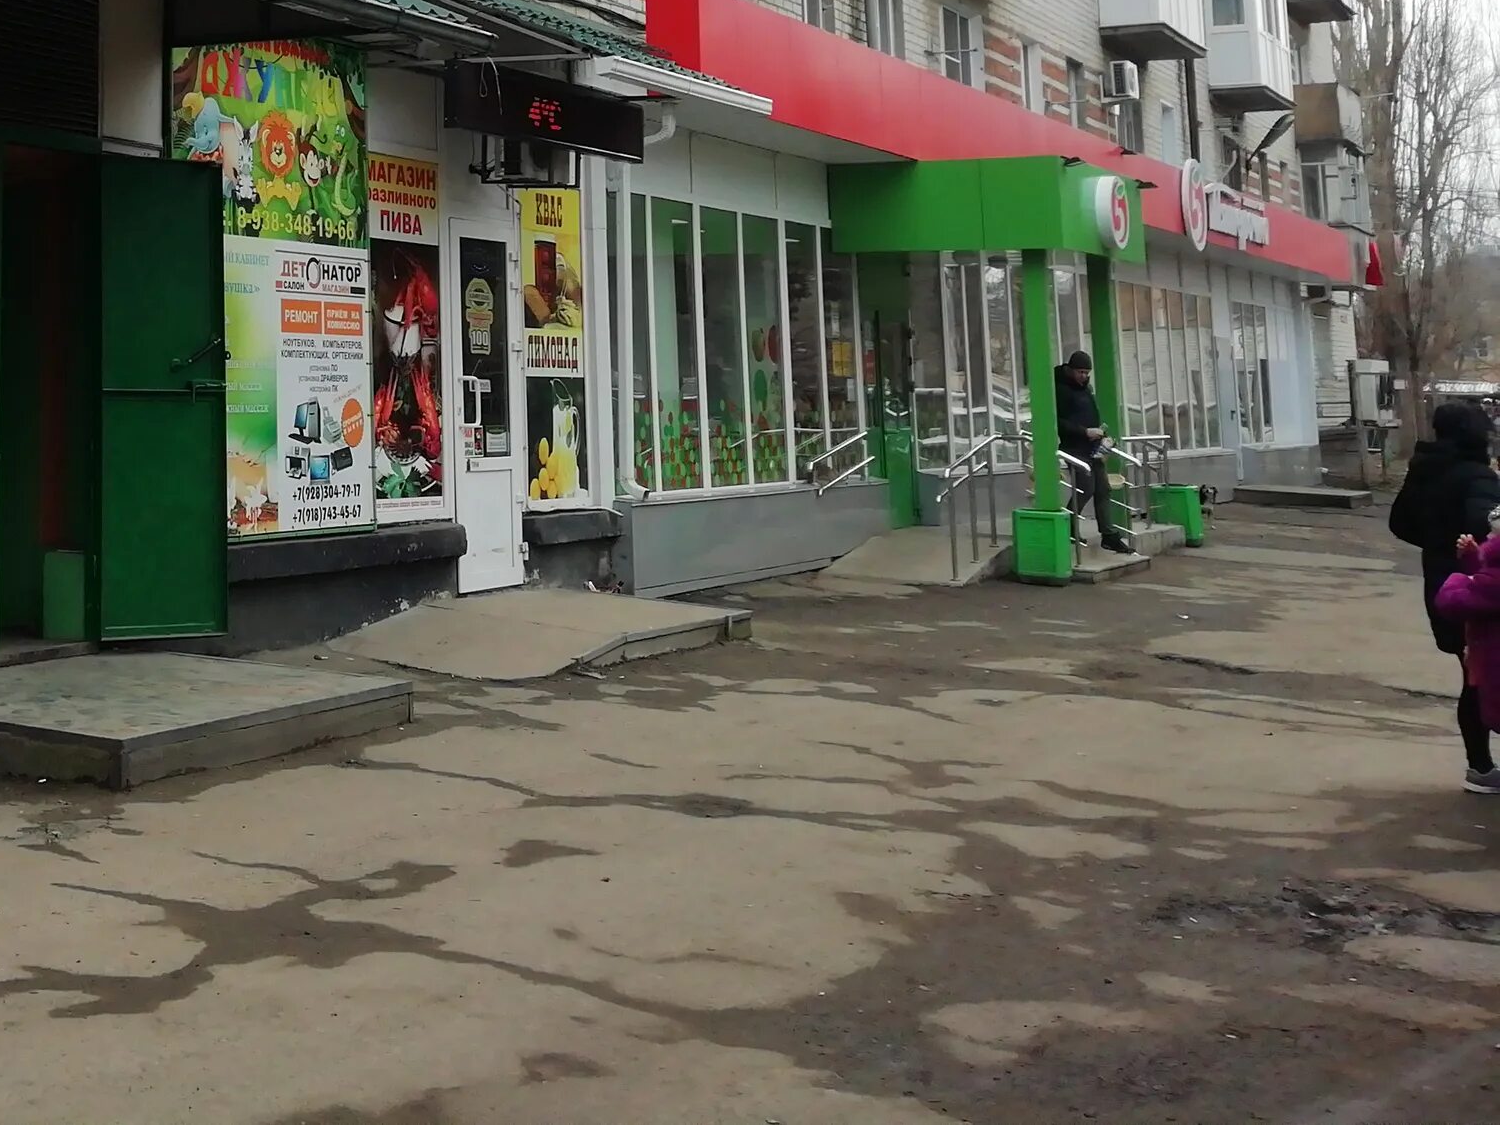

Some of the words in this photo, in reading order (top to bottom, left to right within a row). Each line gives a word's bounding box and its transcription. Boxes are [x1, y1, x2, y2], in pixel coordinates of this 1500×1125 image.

[535, 192, 563, 228] КВАС
[237, 206, 355, 241] 8-938-348-19-66
[380, 210, 422, 236] ПИВА
[280, 257, 362, 289] ДЕТОНАТОР
[283, 280, 305, 290] САЛОН
[322, 283, 350, 294] МАГАЗИН
[284, 309, 318, 324] РЕМОНТ
[471, 330, 488, 346] 100
[527, 335, 578, 372] ЛИМОНАД
[293, 483, 361, 502] +7(928)304-79-17
[293, 505, 362, 526] +7(918)743-45-67
